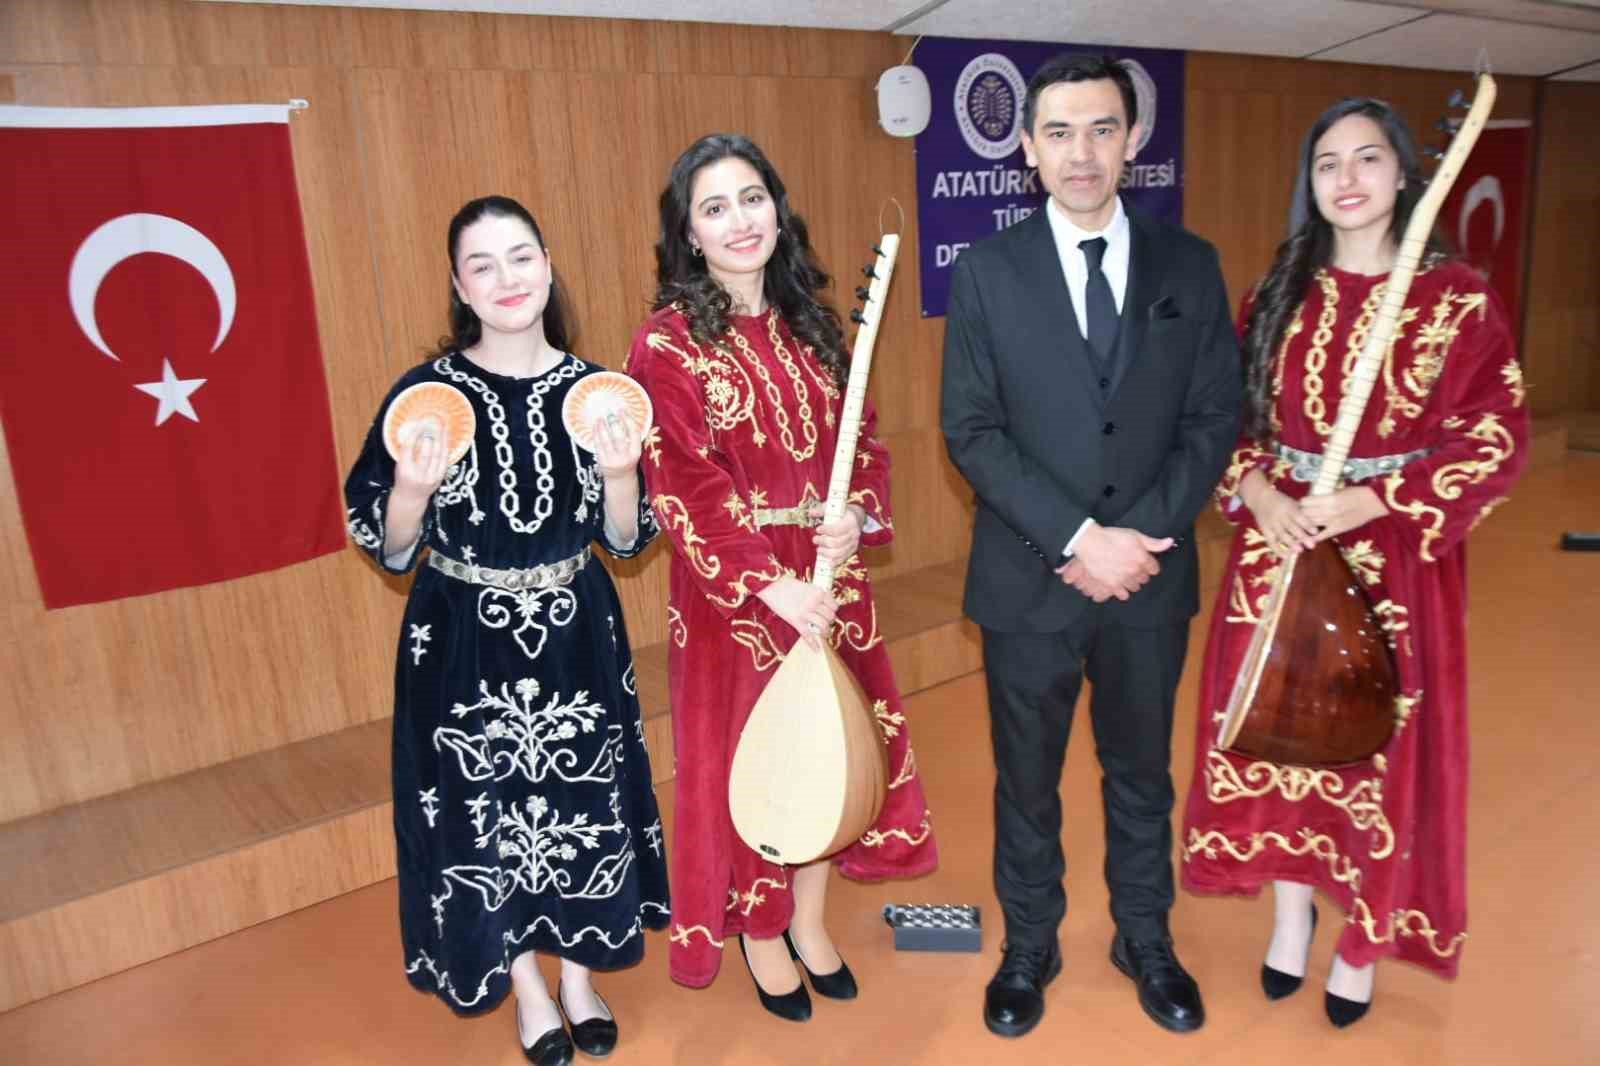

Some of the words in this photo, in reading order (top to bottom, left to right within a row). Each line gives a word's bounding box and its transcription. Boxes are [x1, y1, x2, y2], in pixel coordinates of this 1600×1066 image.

[932, 164, 1038, 198] ATATÜRK
[1118, 158, 1175, 189] SİTESİ
[992, 204, 1038, 231] TÜR
[935, 242, 971, 268] DE
